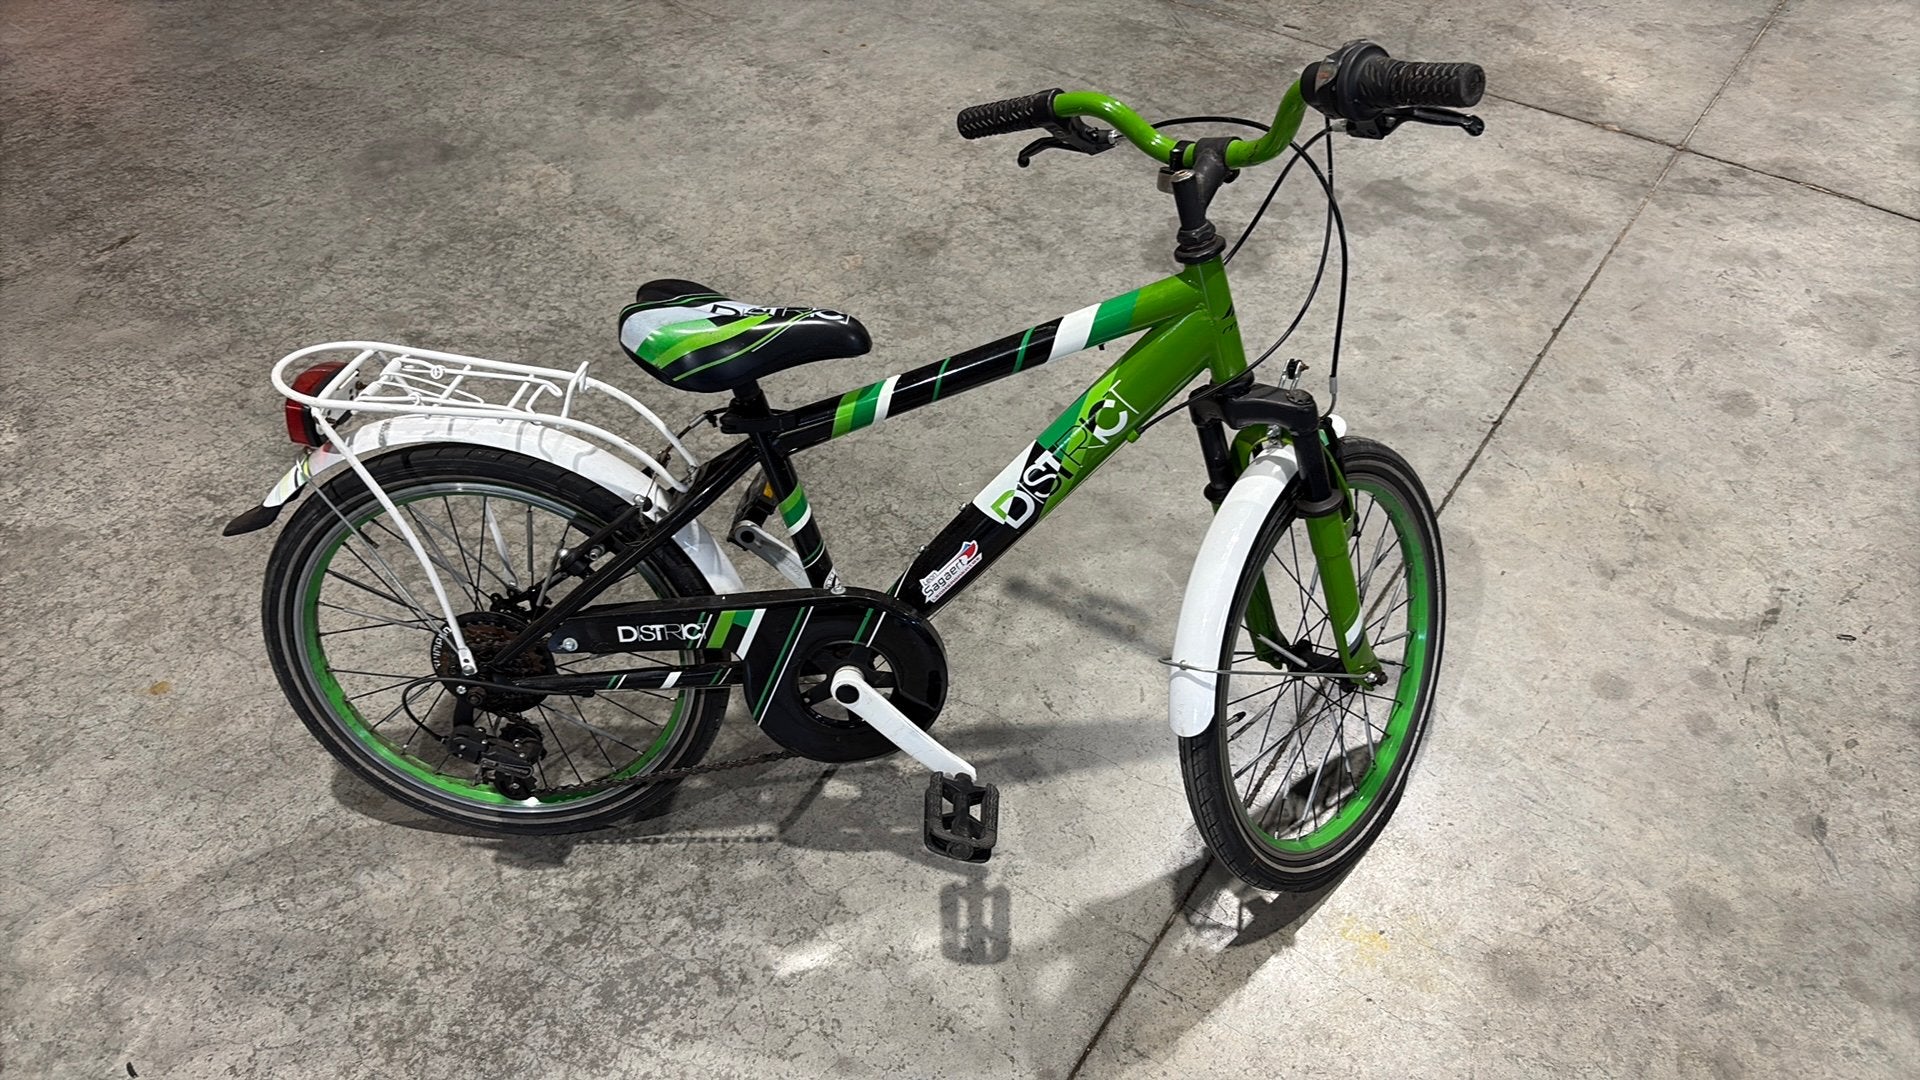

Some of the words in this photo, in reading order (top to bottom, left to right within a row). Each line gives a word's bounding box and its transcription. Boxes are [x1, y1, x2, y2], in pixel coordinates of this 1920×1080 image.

[990, 379, 1140, 529] DISTRICT
[923, 559, 966, 598] Sagaert
[617, 623, 707, 642] DISTRICT
